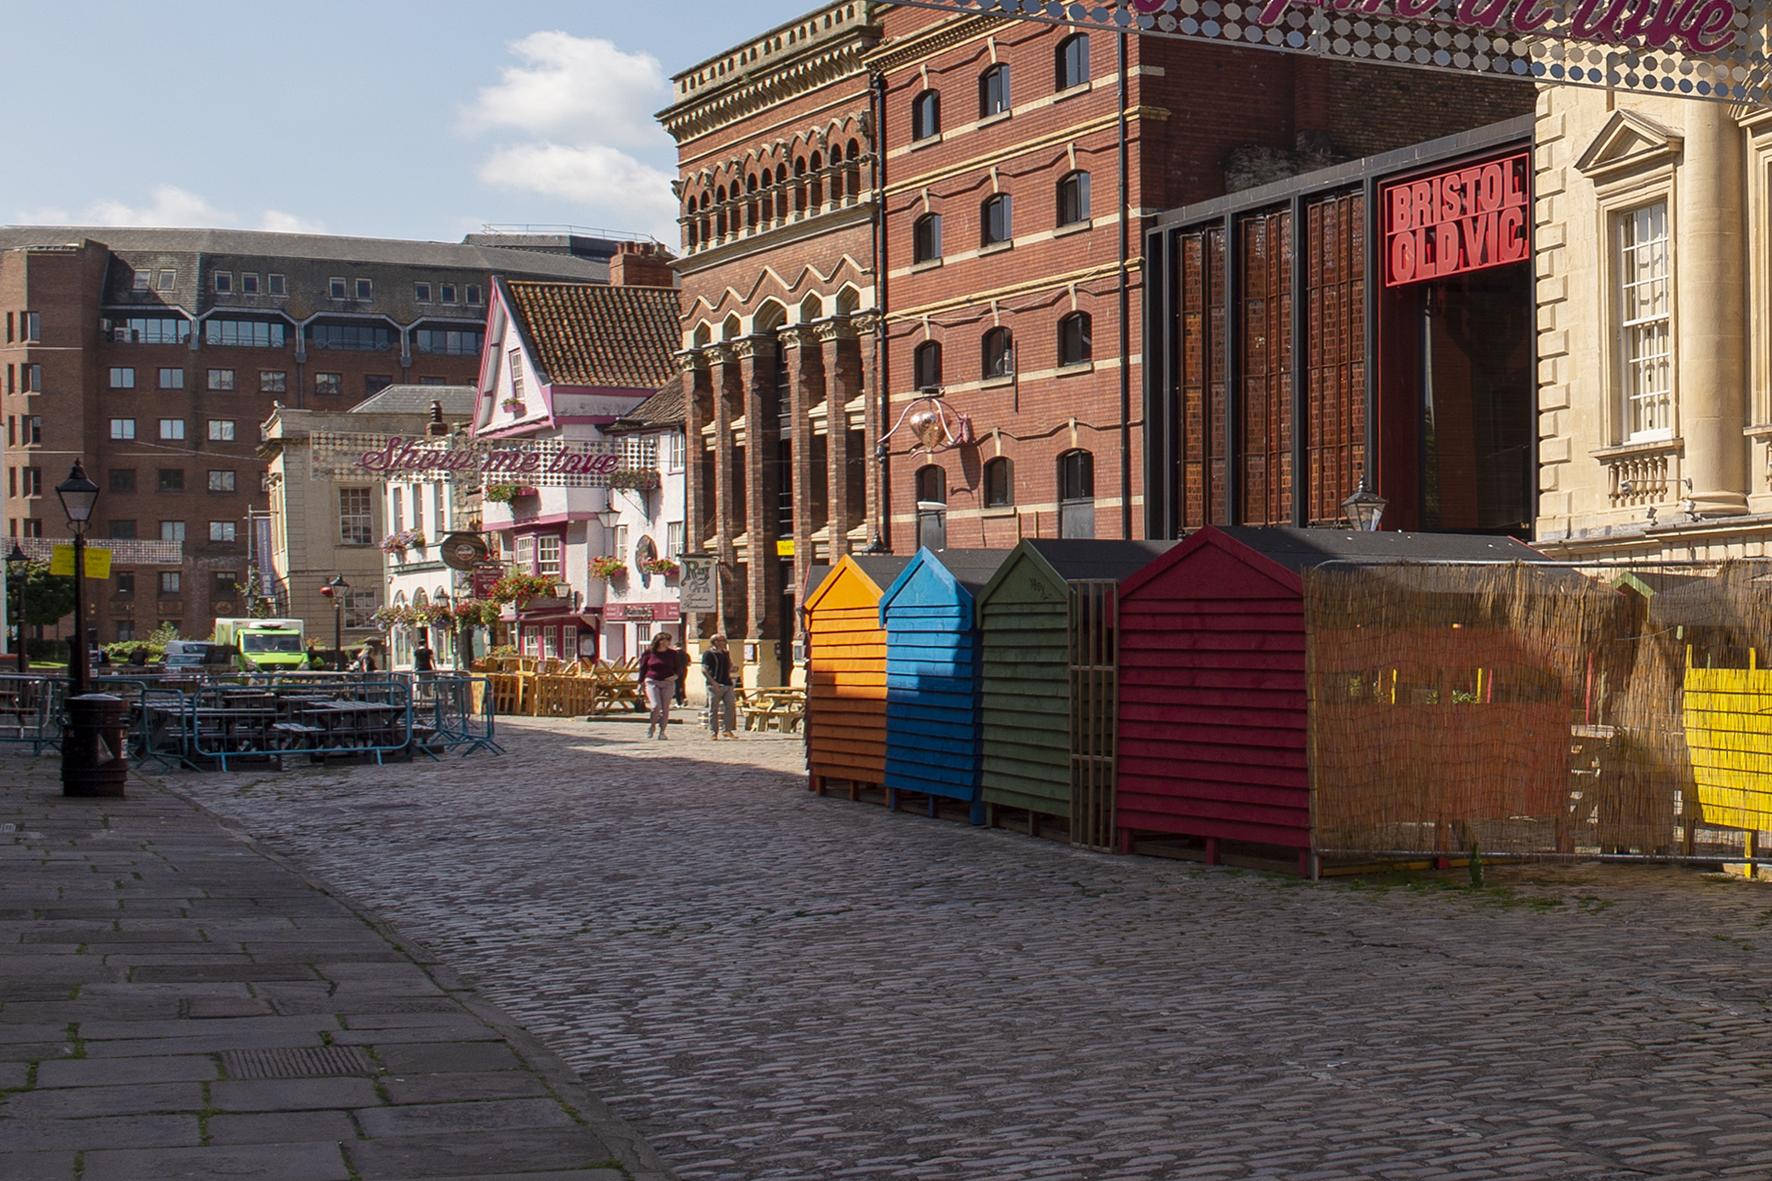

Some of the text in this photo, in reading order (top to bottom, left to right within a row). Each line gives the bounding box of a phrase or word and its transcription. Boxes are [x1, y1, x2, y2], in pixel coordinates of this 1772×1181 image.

[1393, 160, 1523, 232] BRISTOL
[1392, 206, 1523, 282] OLD VIC
[355, 436, 620, 475] Show me love
